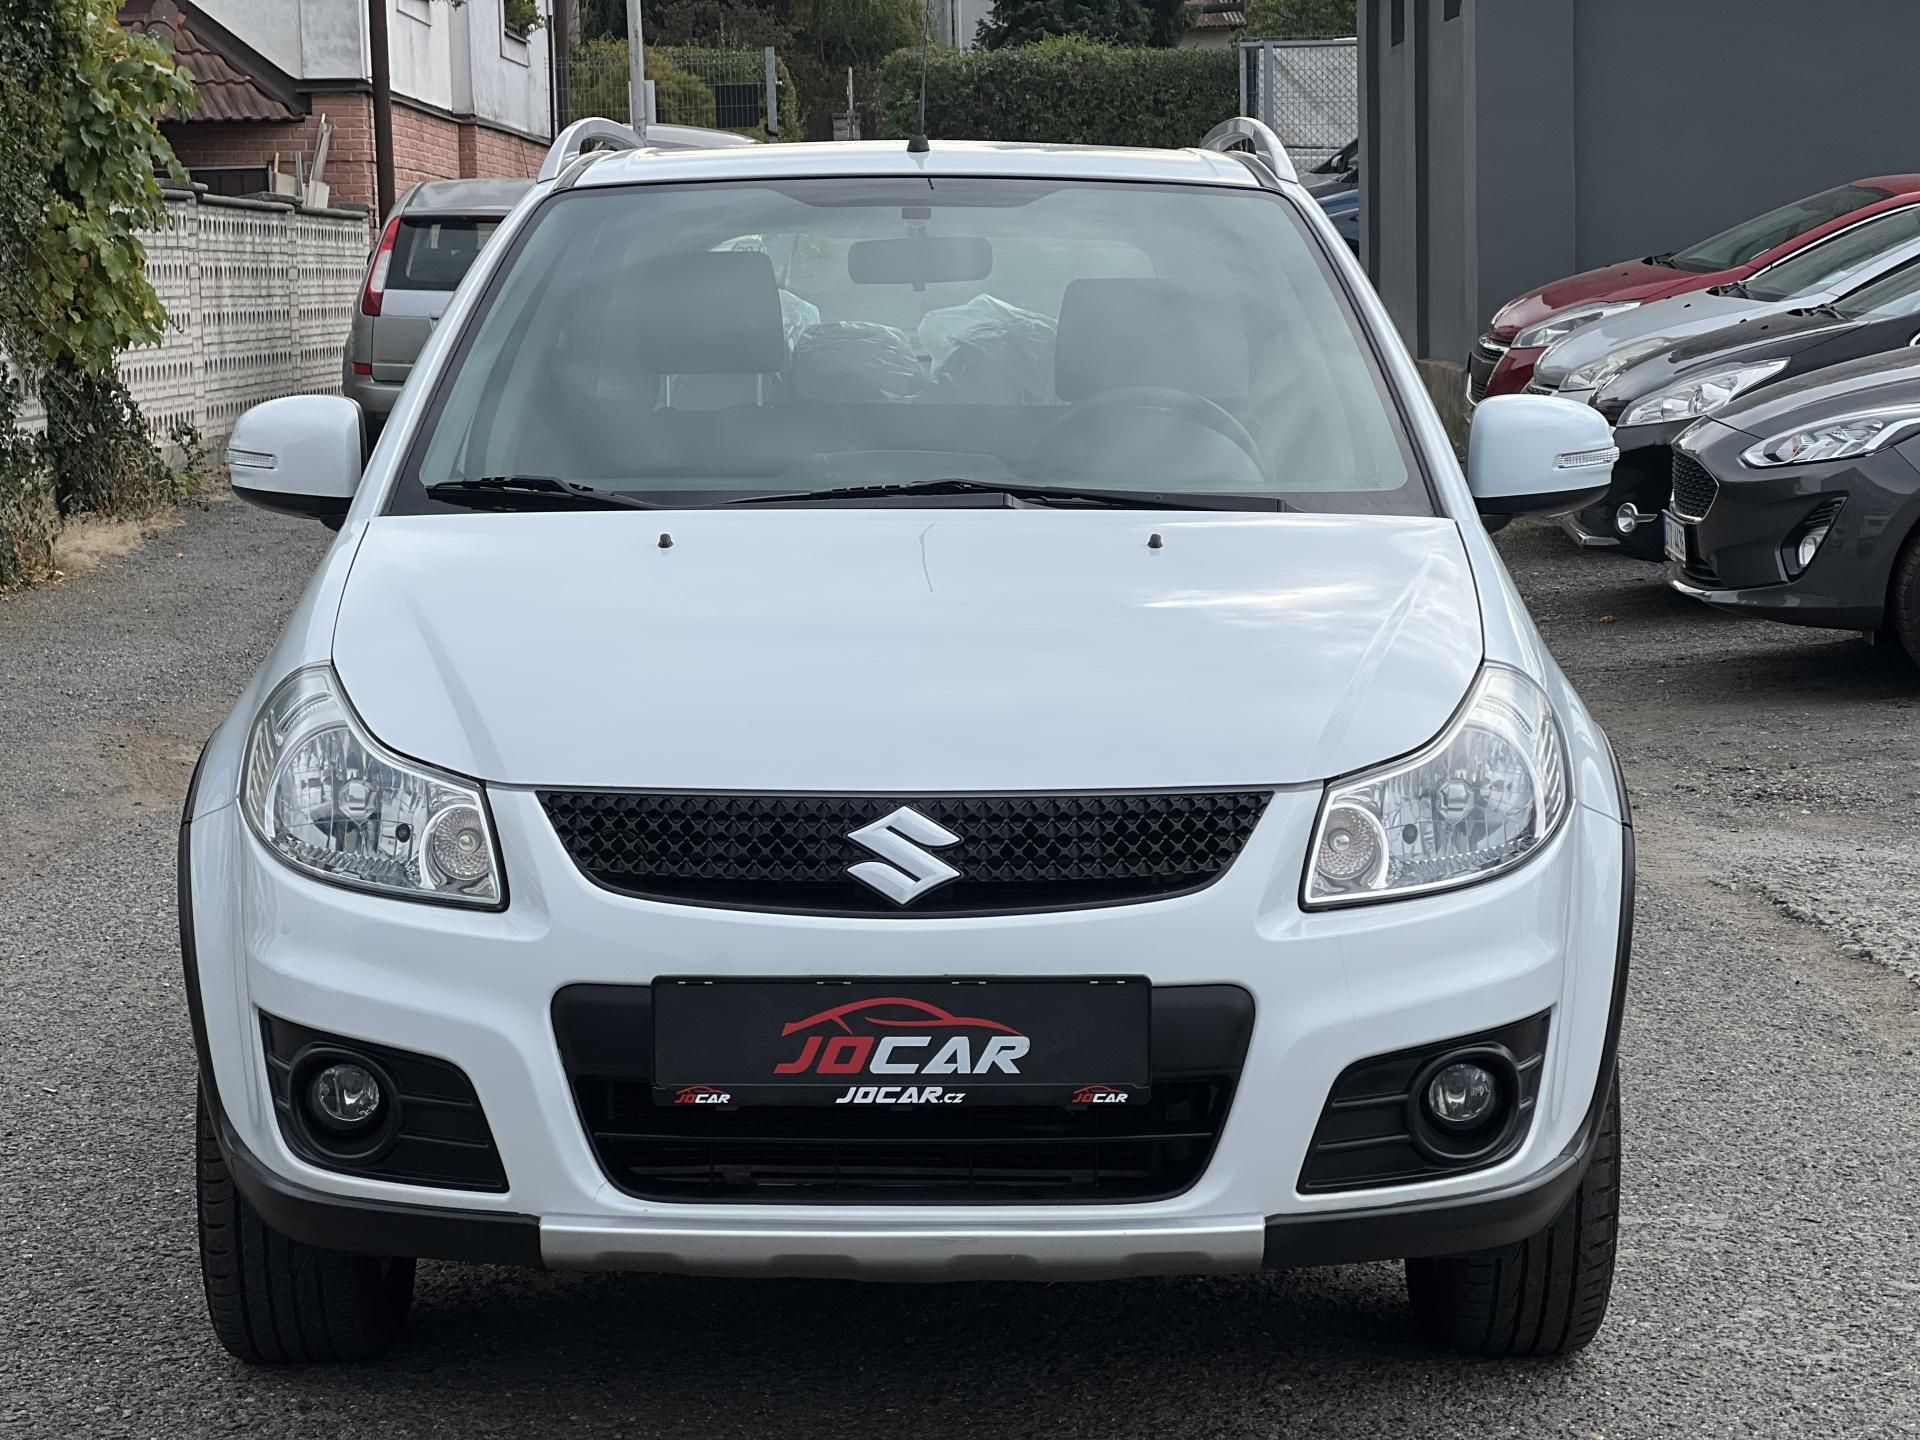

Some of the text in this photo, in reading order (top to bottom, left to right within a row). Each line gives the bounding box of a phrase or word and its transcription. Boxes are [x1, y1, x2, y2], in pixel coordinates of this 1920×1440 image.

[773, 1035, 1031, 1074] JOCAR
[674, 1093, 731, 1104] JOCAR
[1071, 1092, 1128, 1103] JOCAR
